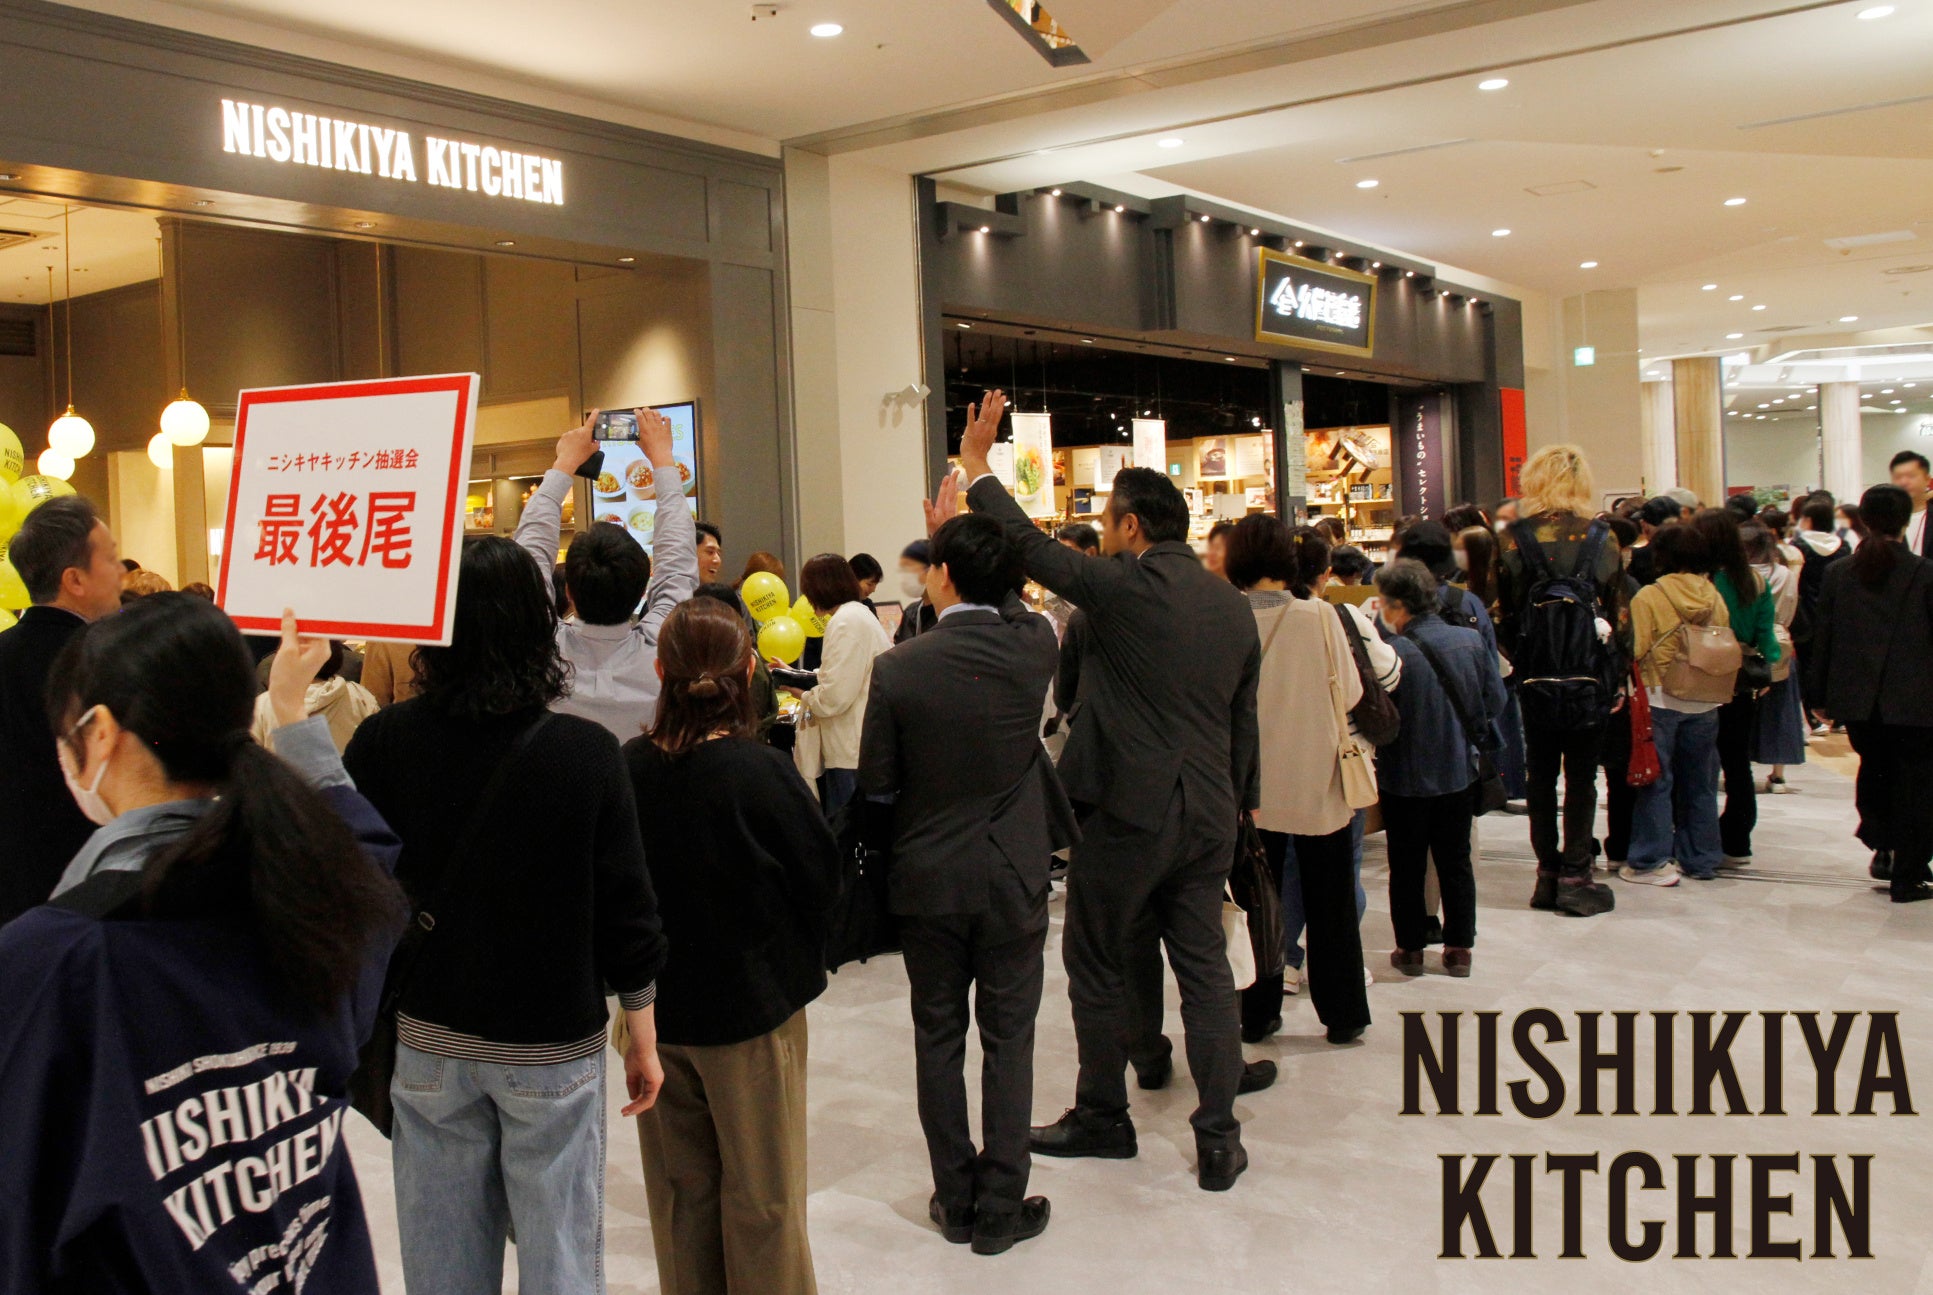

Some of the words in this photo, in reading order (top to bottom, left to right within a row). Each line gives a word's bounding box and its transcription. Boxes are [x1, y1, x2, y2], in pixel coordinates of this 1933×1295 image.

[220, 98, 417, 182] NISHIKIYA
[425, 136, 564, 205] KITCHEN
[267, 448, 420, 472] ニシキヤキッチン抽選会
[253, 491, 417, 569] 最後尾
